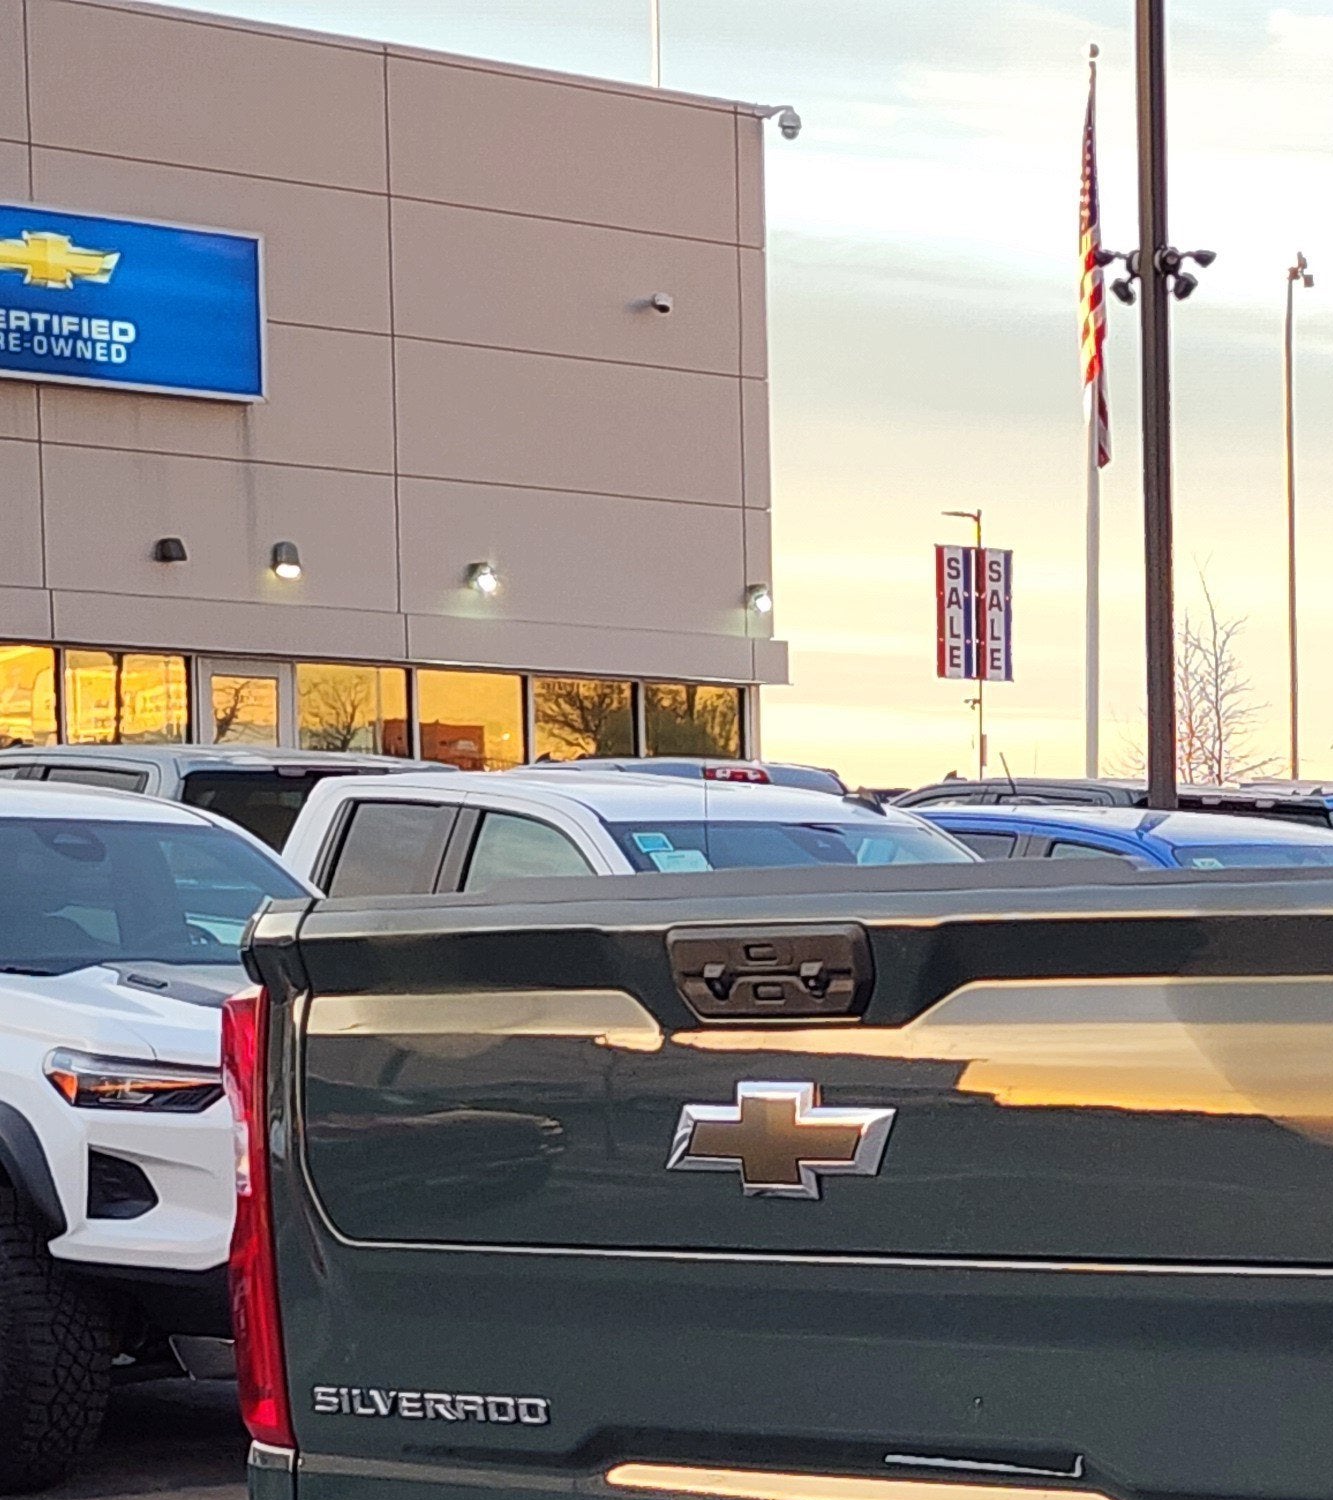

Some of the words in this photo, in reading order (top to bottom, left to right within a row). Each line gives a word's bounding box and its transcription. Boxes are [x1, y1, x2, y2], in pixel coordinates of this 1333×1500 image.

[946, 557, 962, 669] SALE
[988, 561, 1003, 671] SALE
[313, 1386, 549, 1424] SILVERADO
